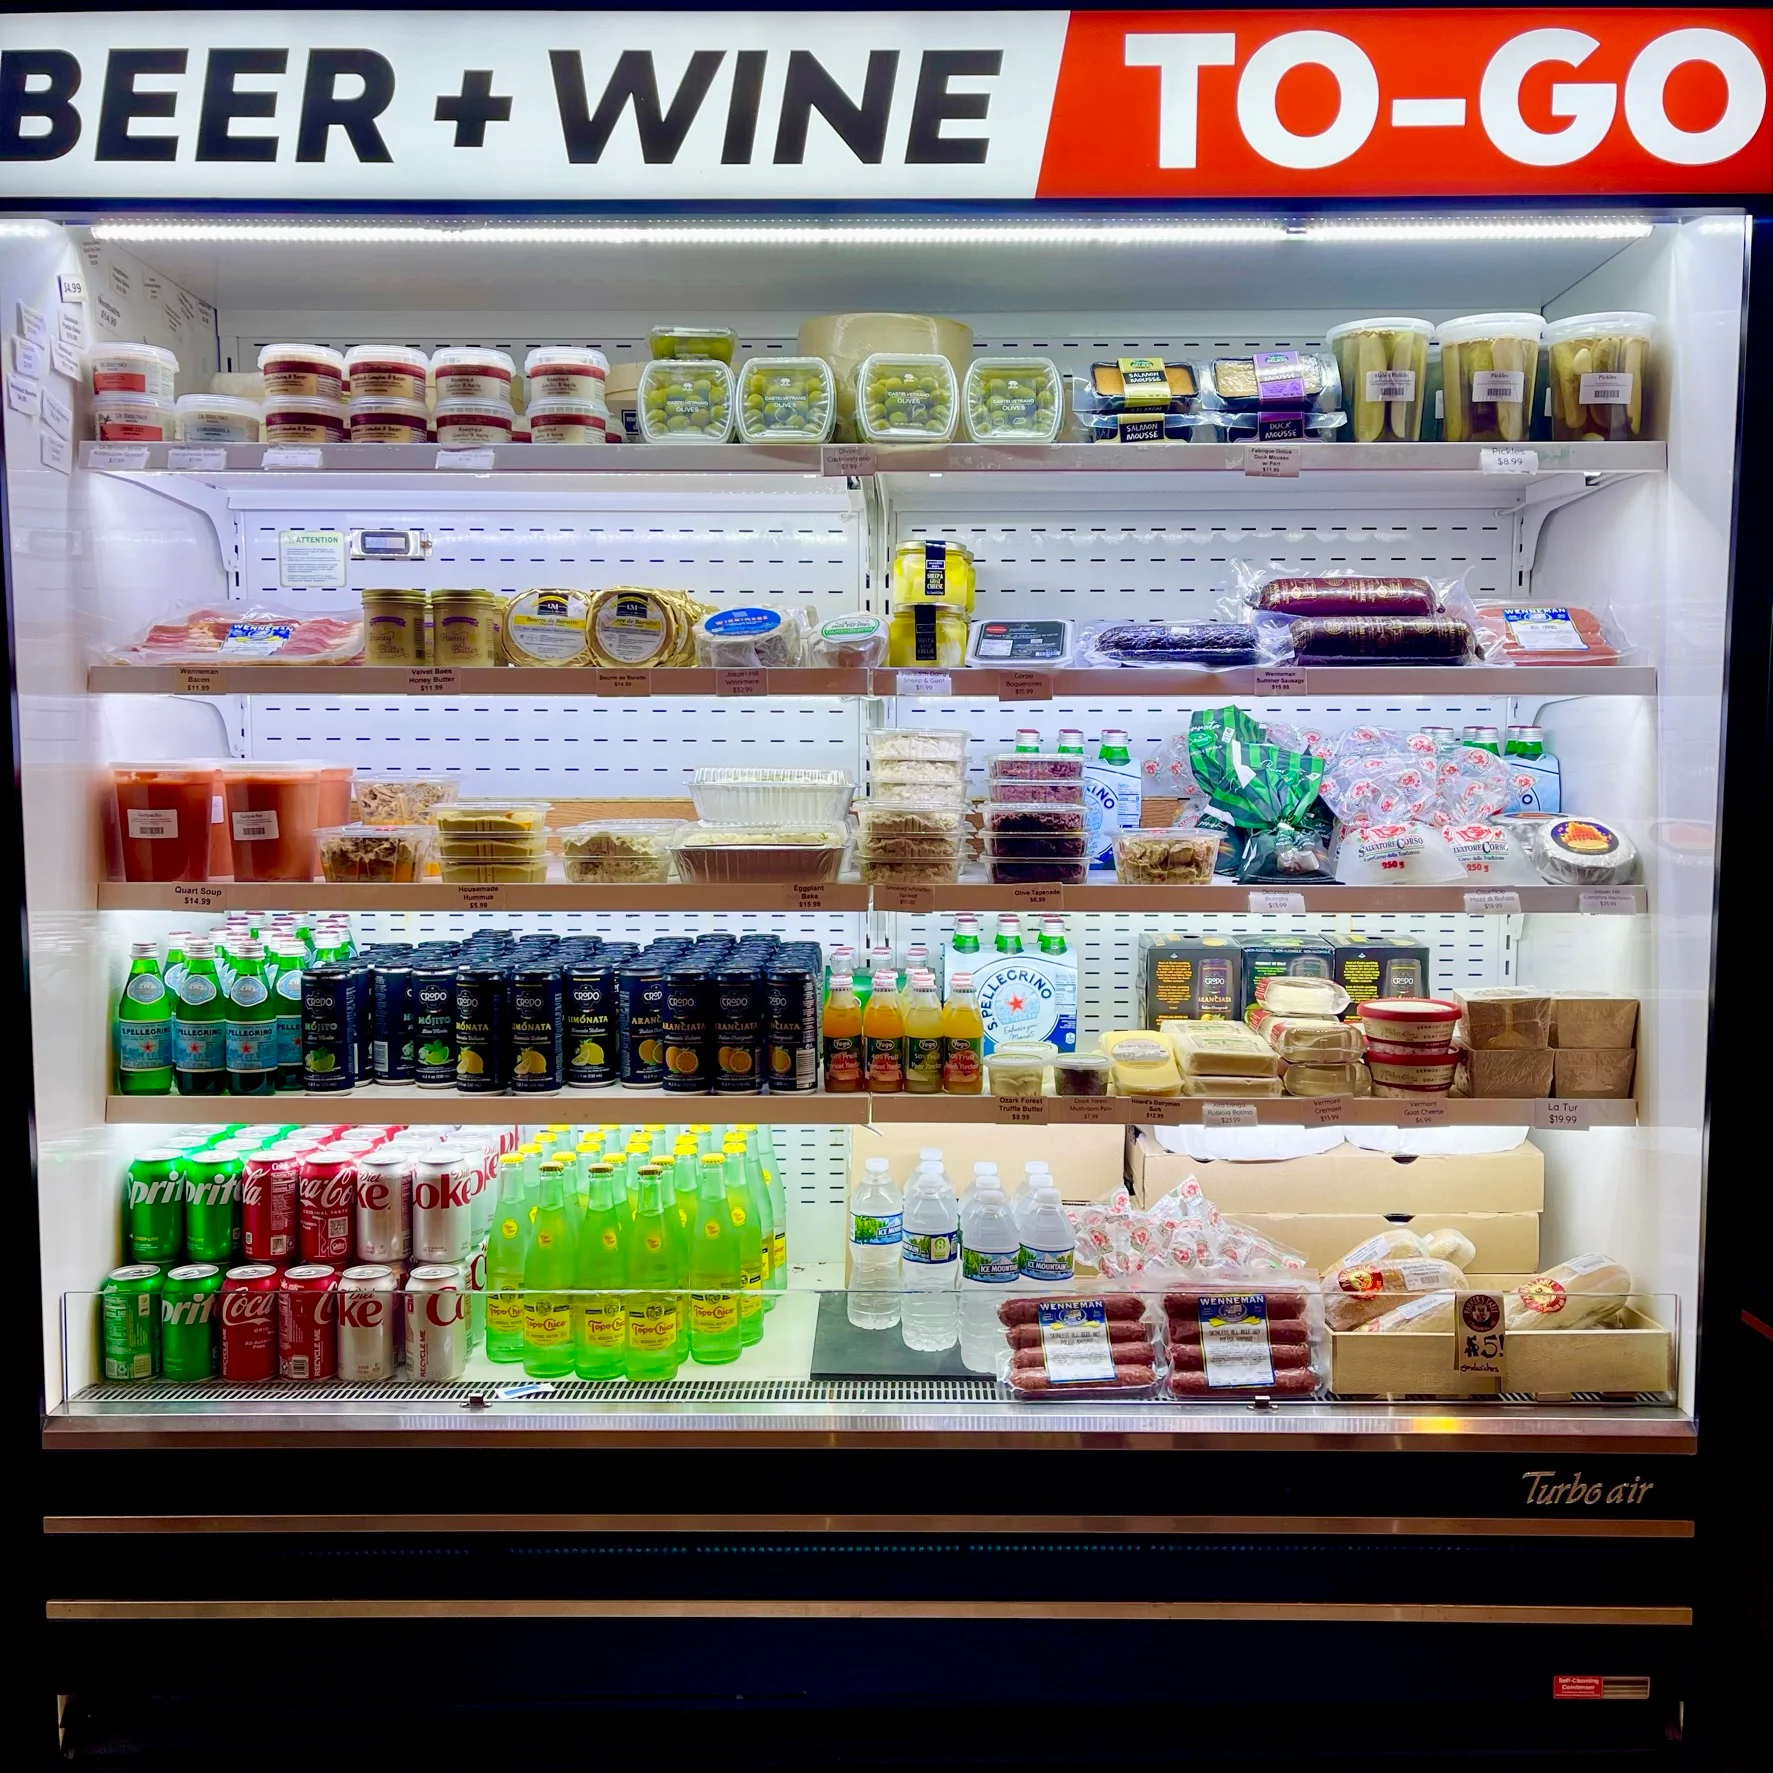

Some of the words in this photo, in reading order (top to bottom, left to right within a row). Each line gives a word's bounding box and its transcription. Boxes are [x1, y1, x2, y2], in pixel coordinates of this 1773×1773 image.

[1123, 27, 1770, 170] TO-GO
[0, 49, 396, 164] BEER
[434, 70, 512, 147] +
[551, 49, 1004, 164] WINE
[64, 283, 81, 293] $4.99
[1269, 422, 1291, 430] DUCK
[1126, 431, 1159, 441] MOUSSE
[1265, 430, 1297, 438] MOUSSE
[1492, 447, 1525, 456] Pickles
[232, 624, 294, 632] WENNEMAN
[409, 677, 432, 685] Honey
[1382, 861, 1397, 869] 250
[1467, 864, 1483, 872] 250
[175, 886, 198, 895] Quart
[200, 888, 222, 897] Soup
[184, 897, 211, 906] $14.99
[1204, 977, 1225, 986] CRODO
[1393, 977, 1413, 986] CRODO
[420, 992, 447, 1000] CRODO
[573, 992, 599, 1000] CRODO
[981, 969, 1052, 1031] S.PELLEGRINO
[669, 998, 694, 1007] CRODO
[722, 998, 747, 1006] CRODO
[568, 1014, 608, 1023] LIMÓNATA
[1132, 1098, 1152, 1106] Hoard's
[1313, 1098, 1341, 1106] Vermont
[1410, 1100, 1437, 1108] Vermont
[1314, 1106, 1342, 1114] Cremont
[1548, 1102, 1559, 1111] La
[1562, 1103, 1578, 1112] Tur
[1549, 1114, 1577, 1124] $19.99
[416, 1174, 471, 1209] oke
[357, 1183, 389, 1211] ke
[878, 1228, 888, 1236] ICE
[991, 1264, 1018, 1272] MOUNTAIN
[1038, 1262, 1067, 1271] MOUNTAIN
[1200, 1295, 1264, 1306] WENNEMAN
[1039, 1300, 1103, 1311] WENNEMAN
[339, 1295, 383, 1327] ke
[489, 1305, 509, 1317] Topo
[694, 1305, 714, 1317] Topo
[712, 1307, 734, 1318] Chico
[526, 1318, 545, 1331] Topo
[543, 1320, 567, 1331] Chico
[588, 1320, 609, 1333] Topo
[632, 1322, 656, 1335] Topo
[654, 1322, 675, 1335] Chico
[315, 1329, 320, 1341] ME
[420, 1330, 426, 1341] ME
[1522, 1471, 1602, 1504] Turbo
[1606, 1476, 1653, 1504] air
